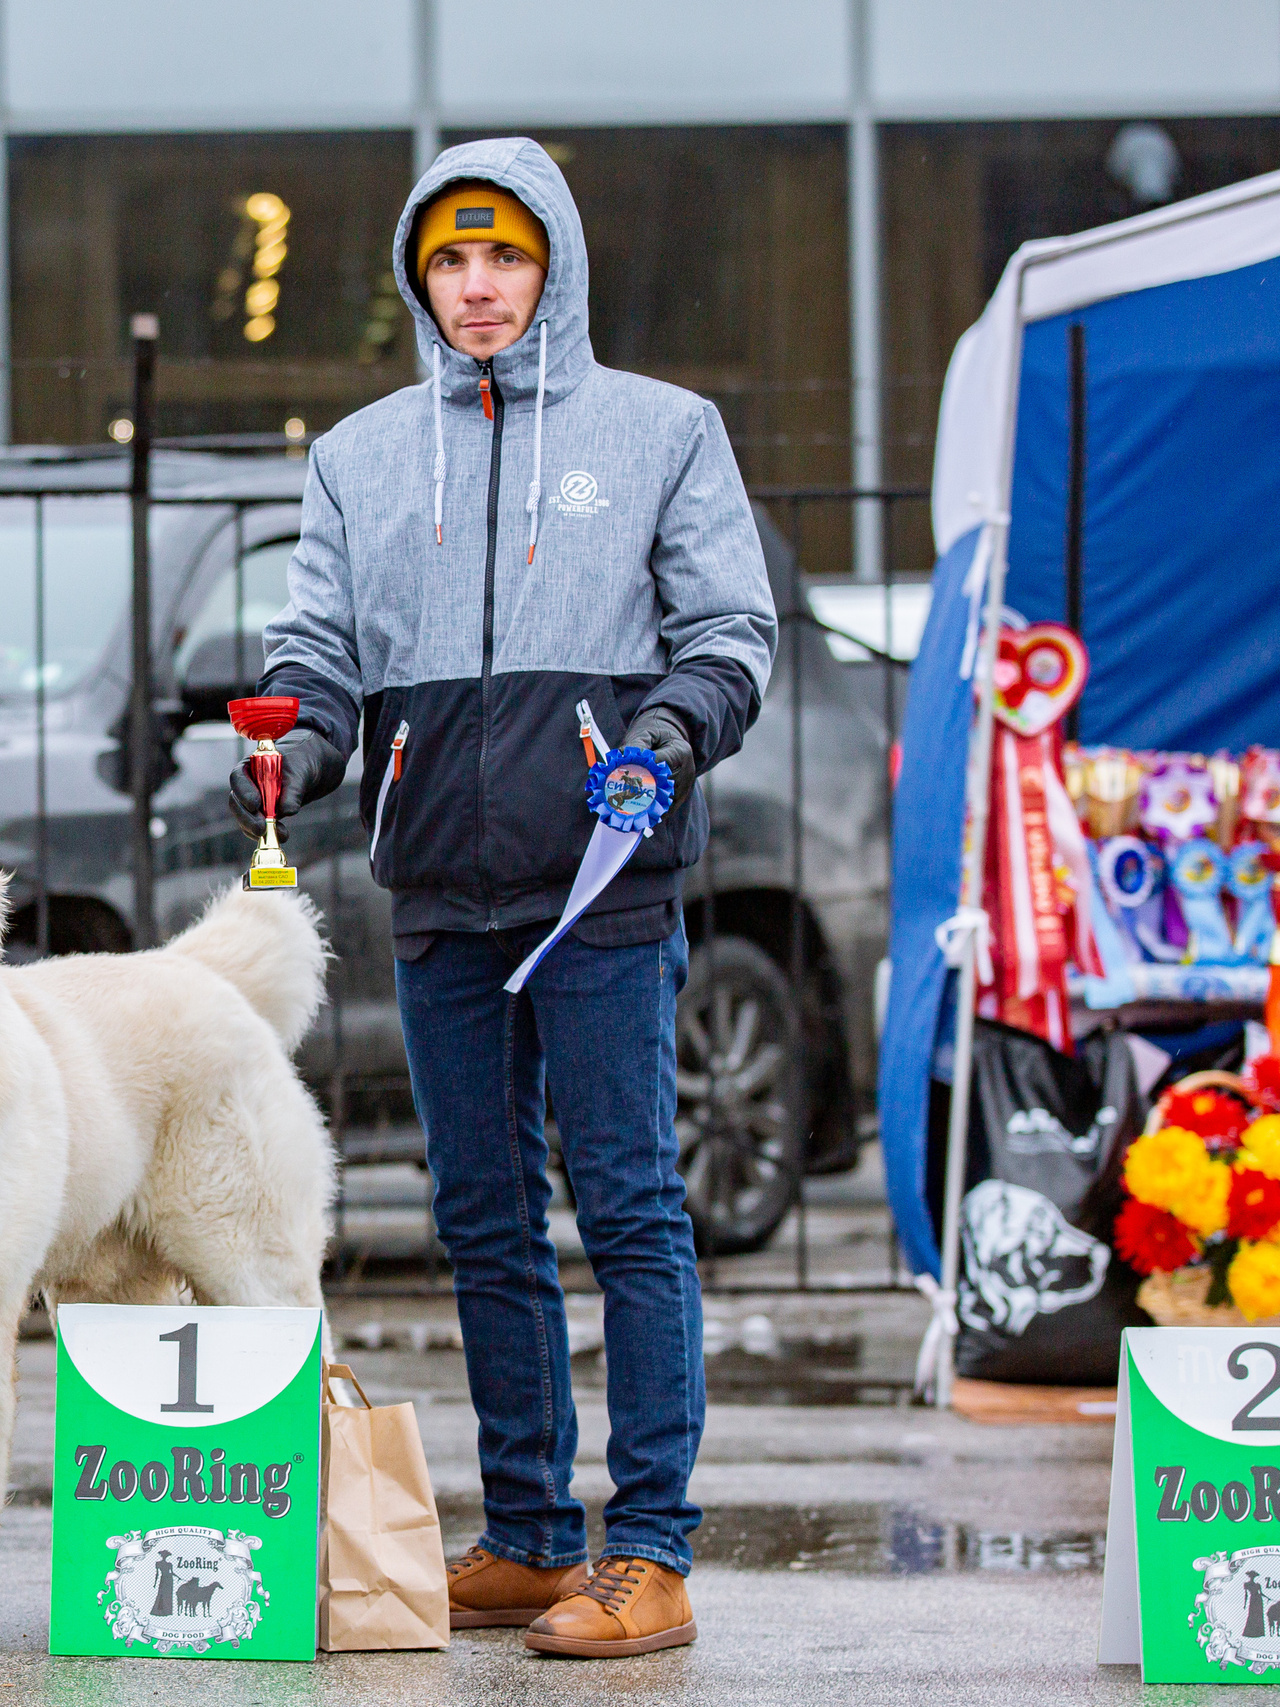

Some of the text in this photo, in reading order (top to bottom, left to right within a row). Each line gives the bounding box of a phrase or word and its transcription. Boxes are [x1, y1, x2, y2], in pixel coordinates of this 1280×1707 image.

[457, 213, 492, 221] FUTURE
[558, 504, 598, 514] POWERFULL
[607, 781, 654, 798] СИРИУС
[158, 1322, 215, 1414] 1
[1226, 1341, 1280, 1432] 2
[74, 1444, 293, 1519] ZooRing
[155, 1527, 213, 1536] HIGH QUALITY
[1241, 1548, 1261, 1556] HIGH
[177, 1556, 219, 1572] ZooRing
